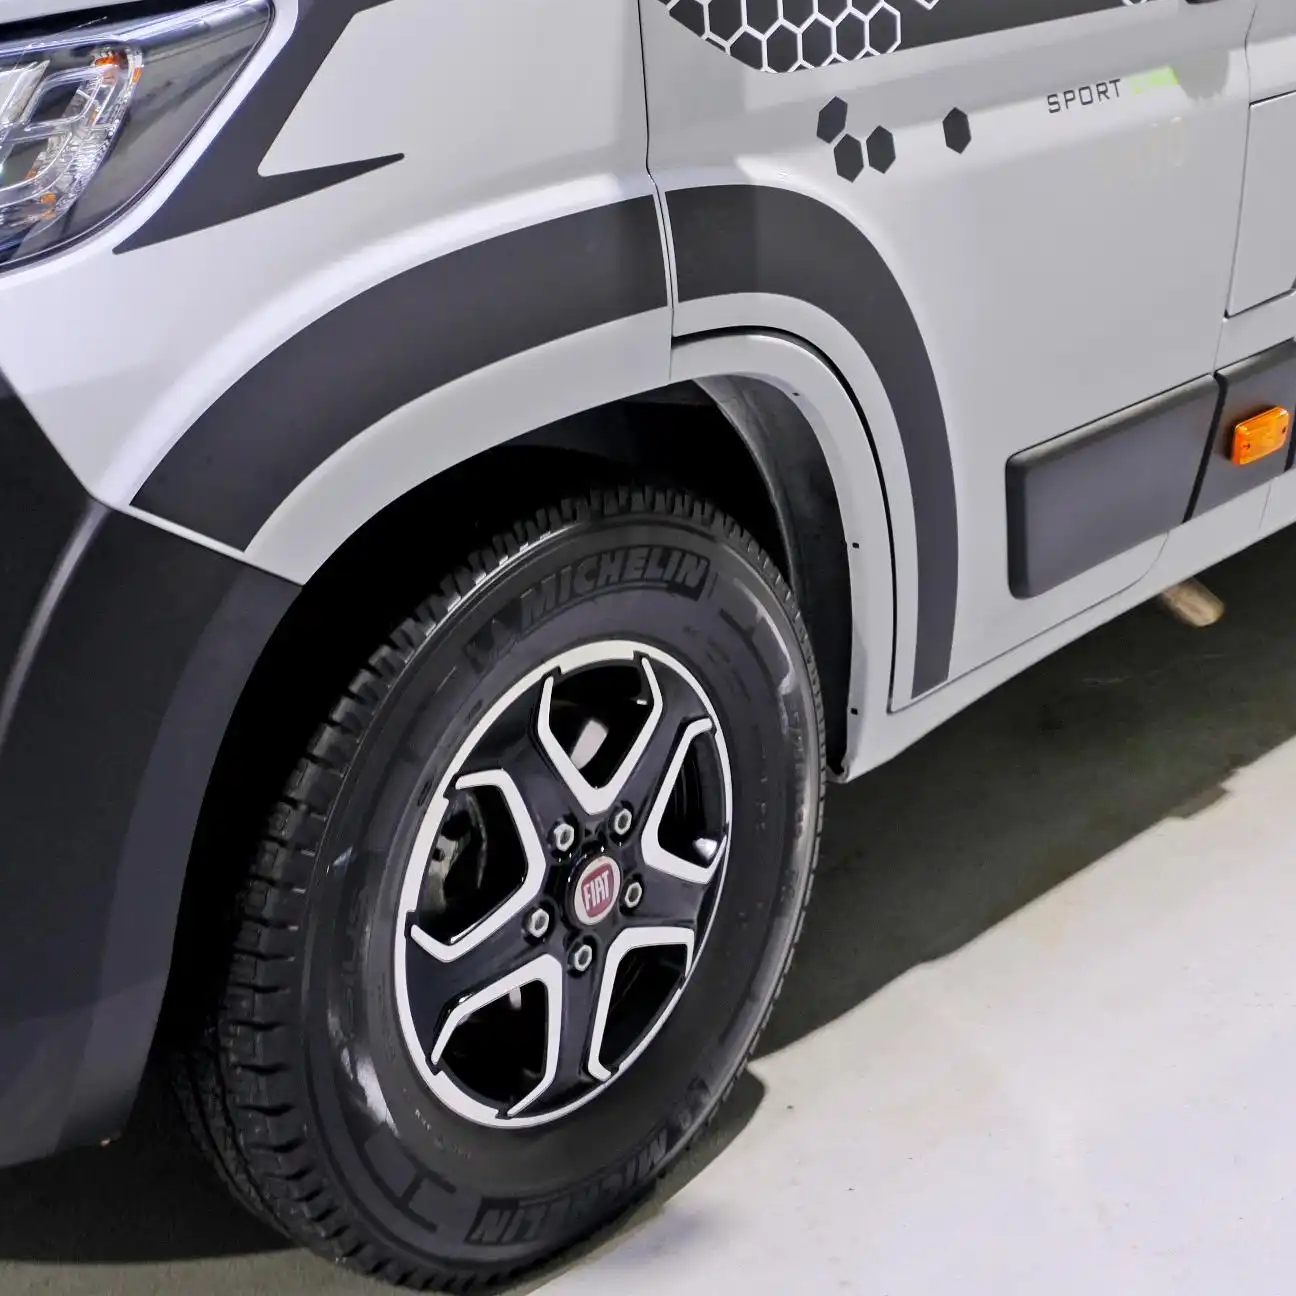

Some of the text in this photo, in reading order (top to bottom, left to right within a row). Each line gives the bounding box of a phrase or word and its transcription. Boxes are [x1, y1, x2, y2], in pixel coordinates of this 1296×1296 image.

[1046, 78, 1121, 114] SPORT
[519, 547, 708, 627] MICHELIN
[583, 869, 610, 911] FIAT
